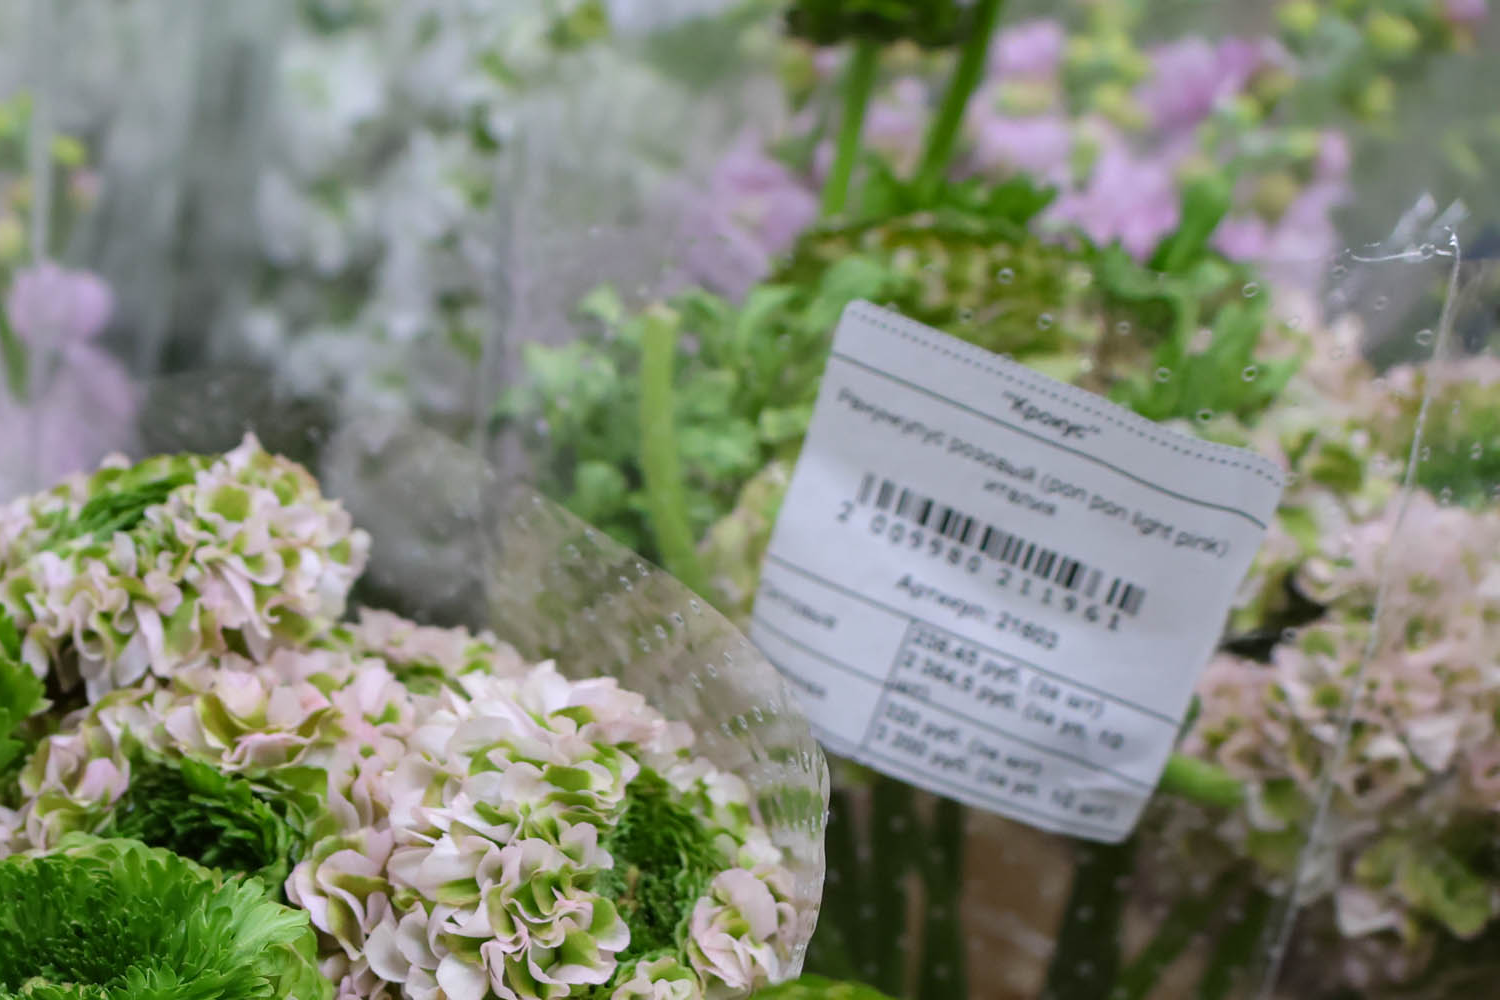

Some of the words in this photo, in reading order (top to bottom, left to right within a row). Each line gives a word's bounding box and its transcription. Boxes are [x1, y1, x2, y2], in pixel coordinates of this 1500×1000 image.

[838, 501, 854, 523] 2
[870, 514, 982, 574] 009980
[997, 567, 1120, 632] 211961
